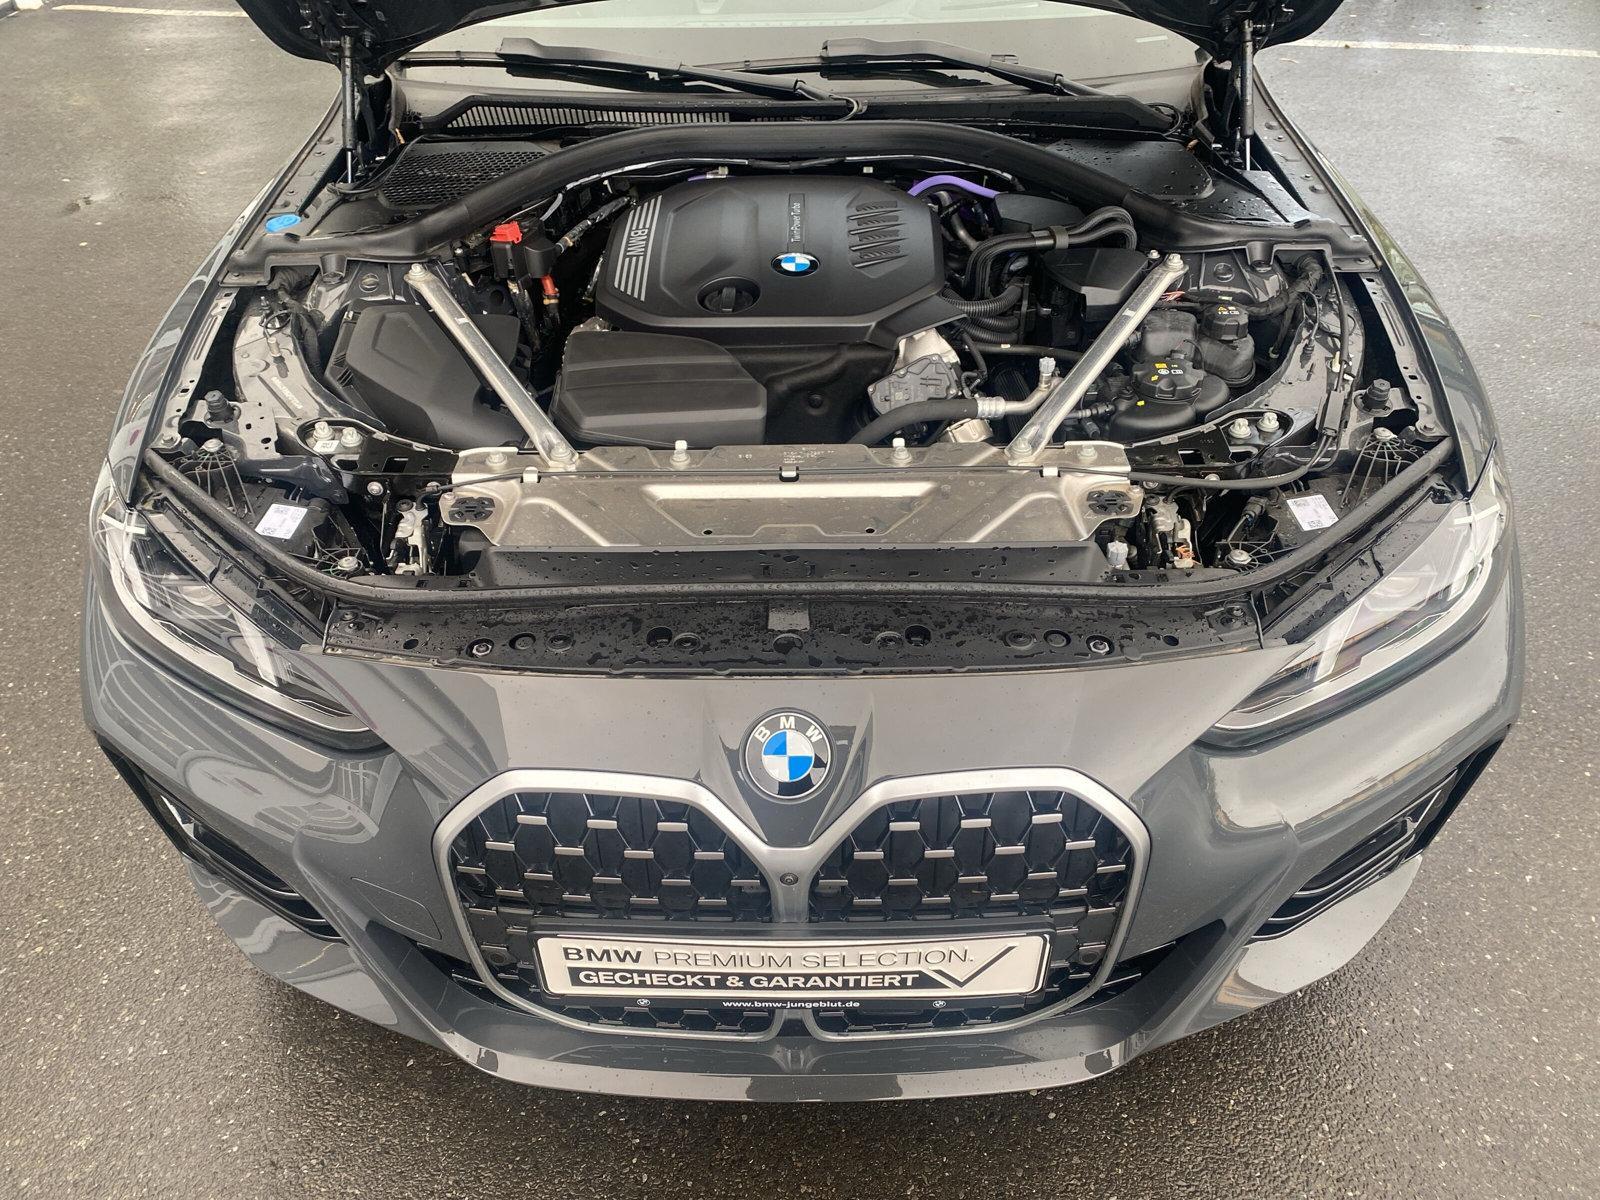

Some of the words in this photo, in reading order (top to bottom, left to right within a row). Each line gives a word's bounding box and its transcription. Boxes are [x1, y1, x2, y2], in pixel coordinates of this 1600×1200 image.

[626, 228, 649, 256] BMW
[754, 716, 823, 743] BMW
[562, 946, 643, 964] BMW
[654, 950, 793, 968] PREMIUM
[579, 970, 722, 987] GECHECKT
[726, 975, 744, 987] &
[749, 974, 919, 988] GARANTIERT
[722, 1000, 860, 1010] www.bmw-jungeblut.de
